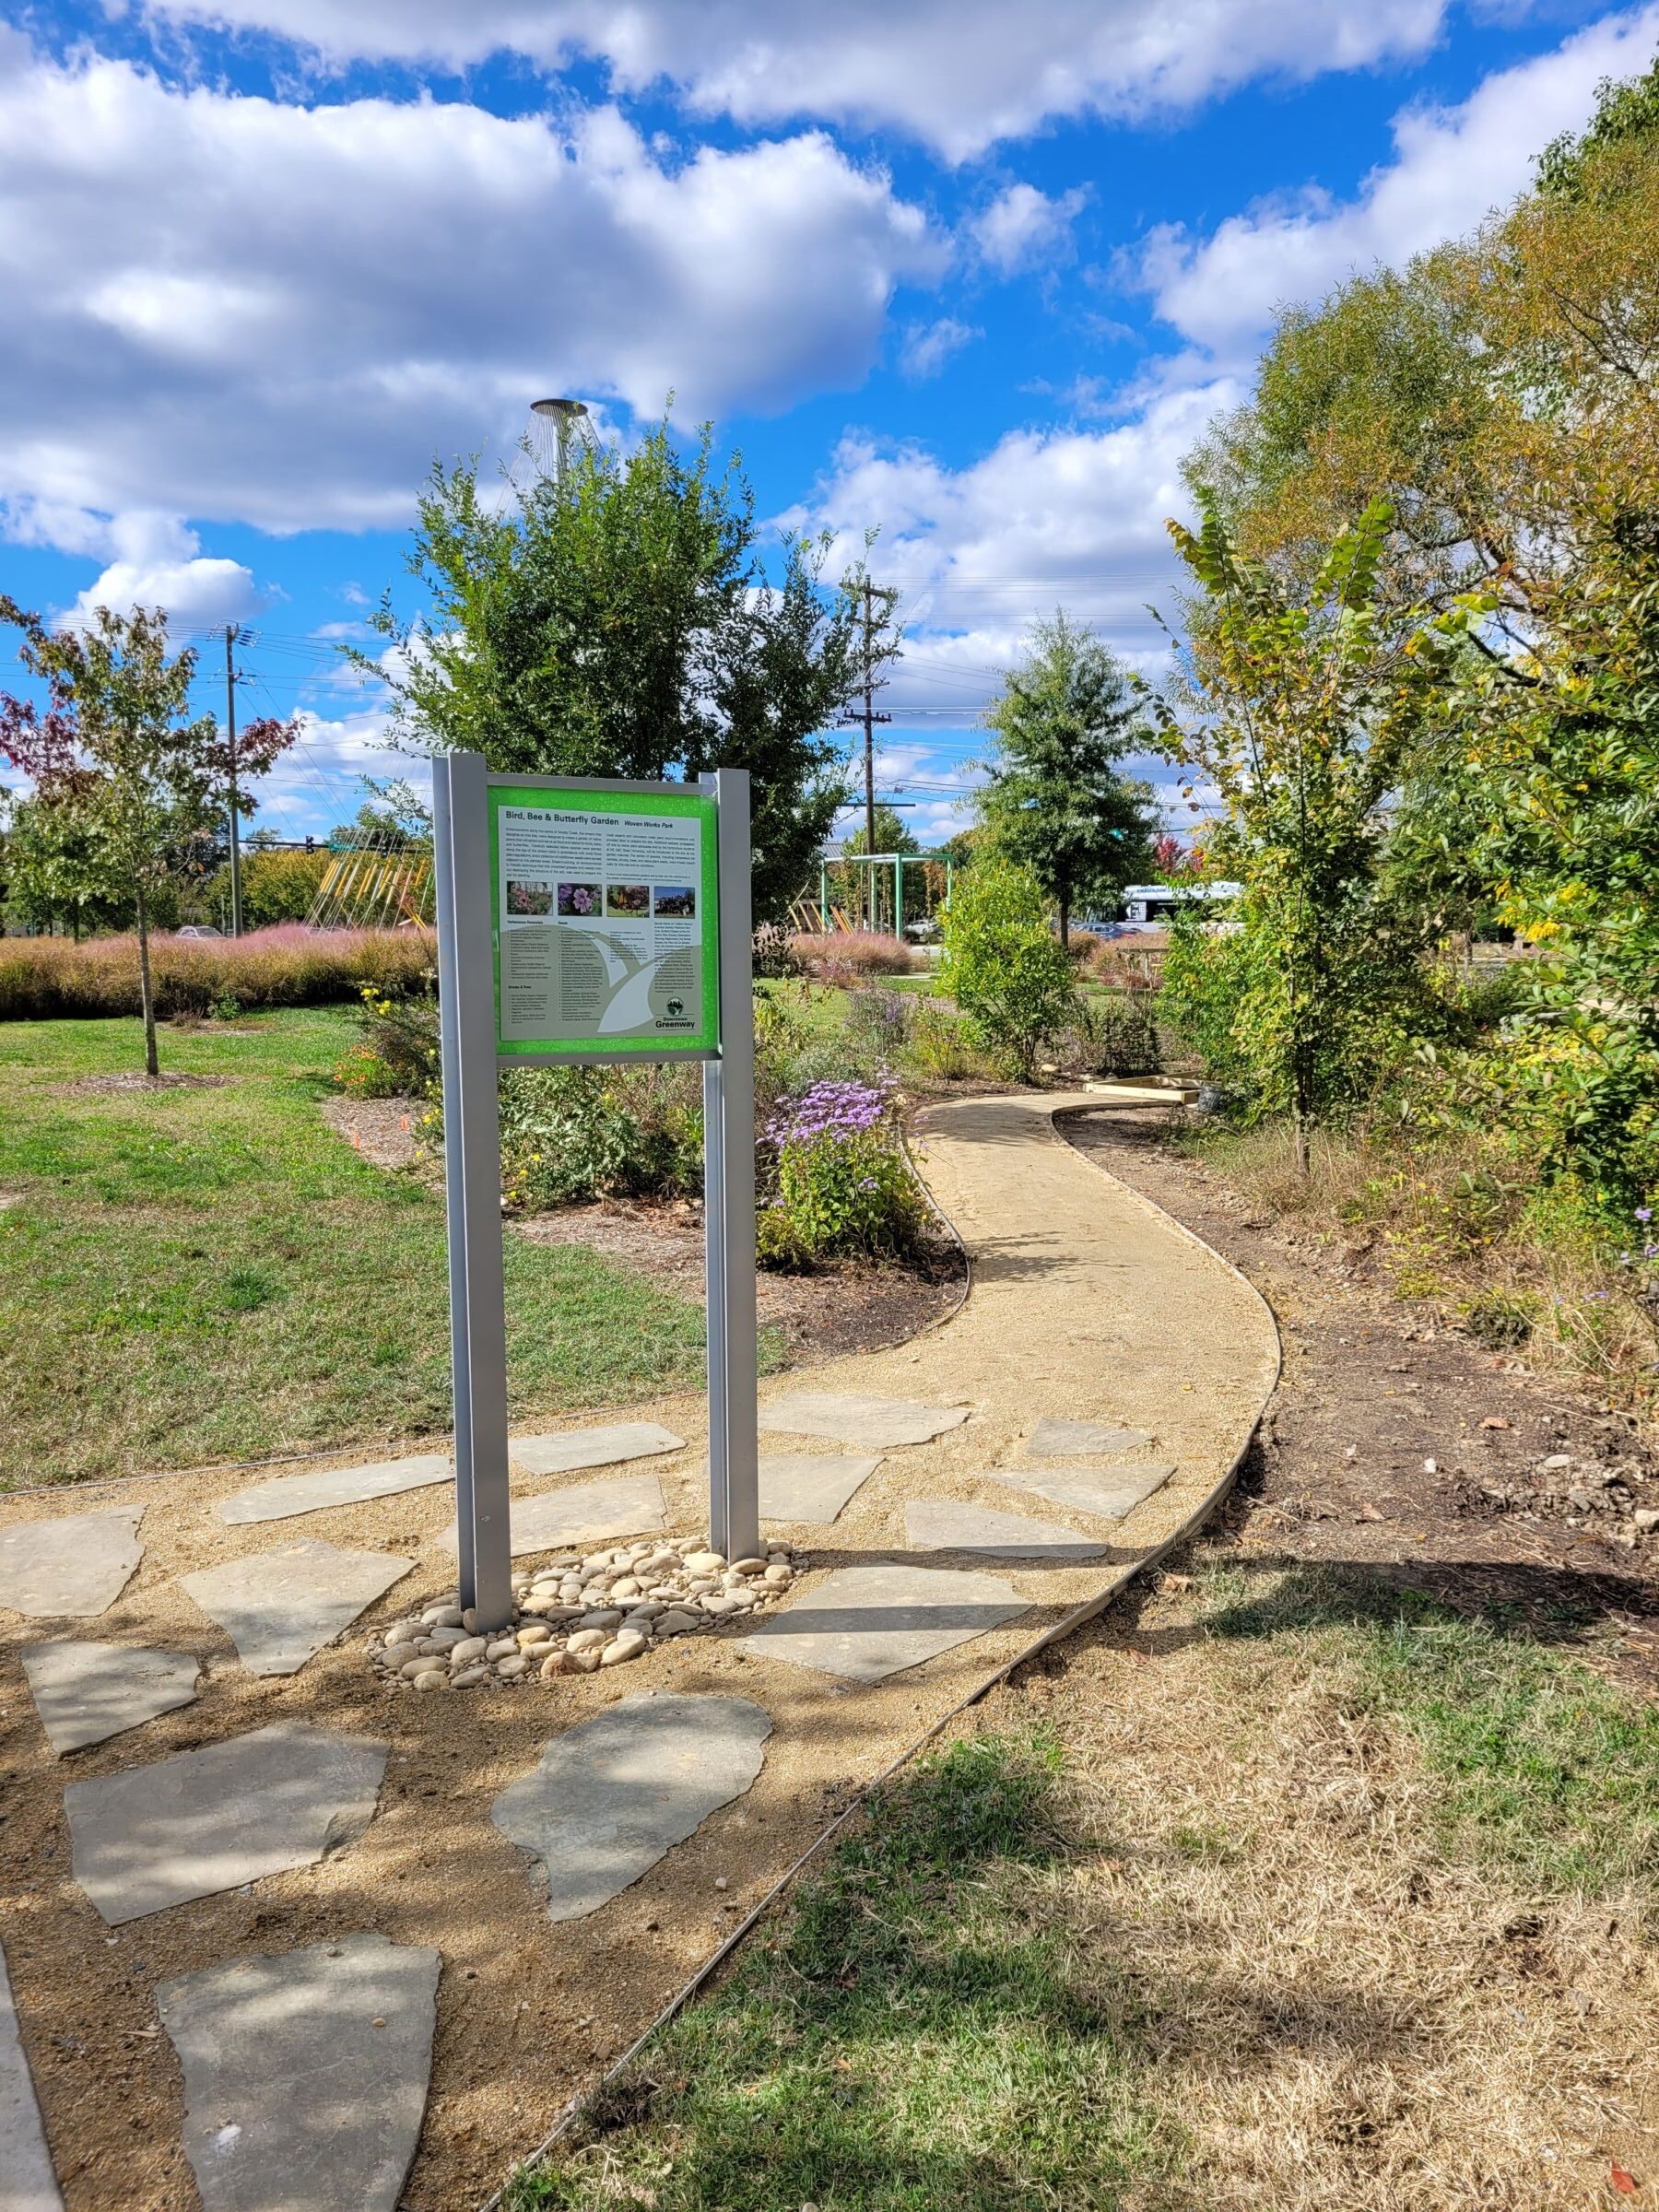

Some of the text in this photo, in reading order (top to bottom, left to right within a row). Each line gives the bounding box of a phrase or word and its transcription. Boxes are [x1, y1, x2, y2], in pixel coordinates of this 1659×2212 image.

[506, 810, 619, 825] Bird, Bee & Butterfly Garden
